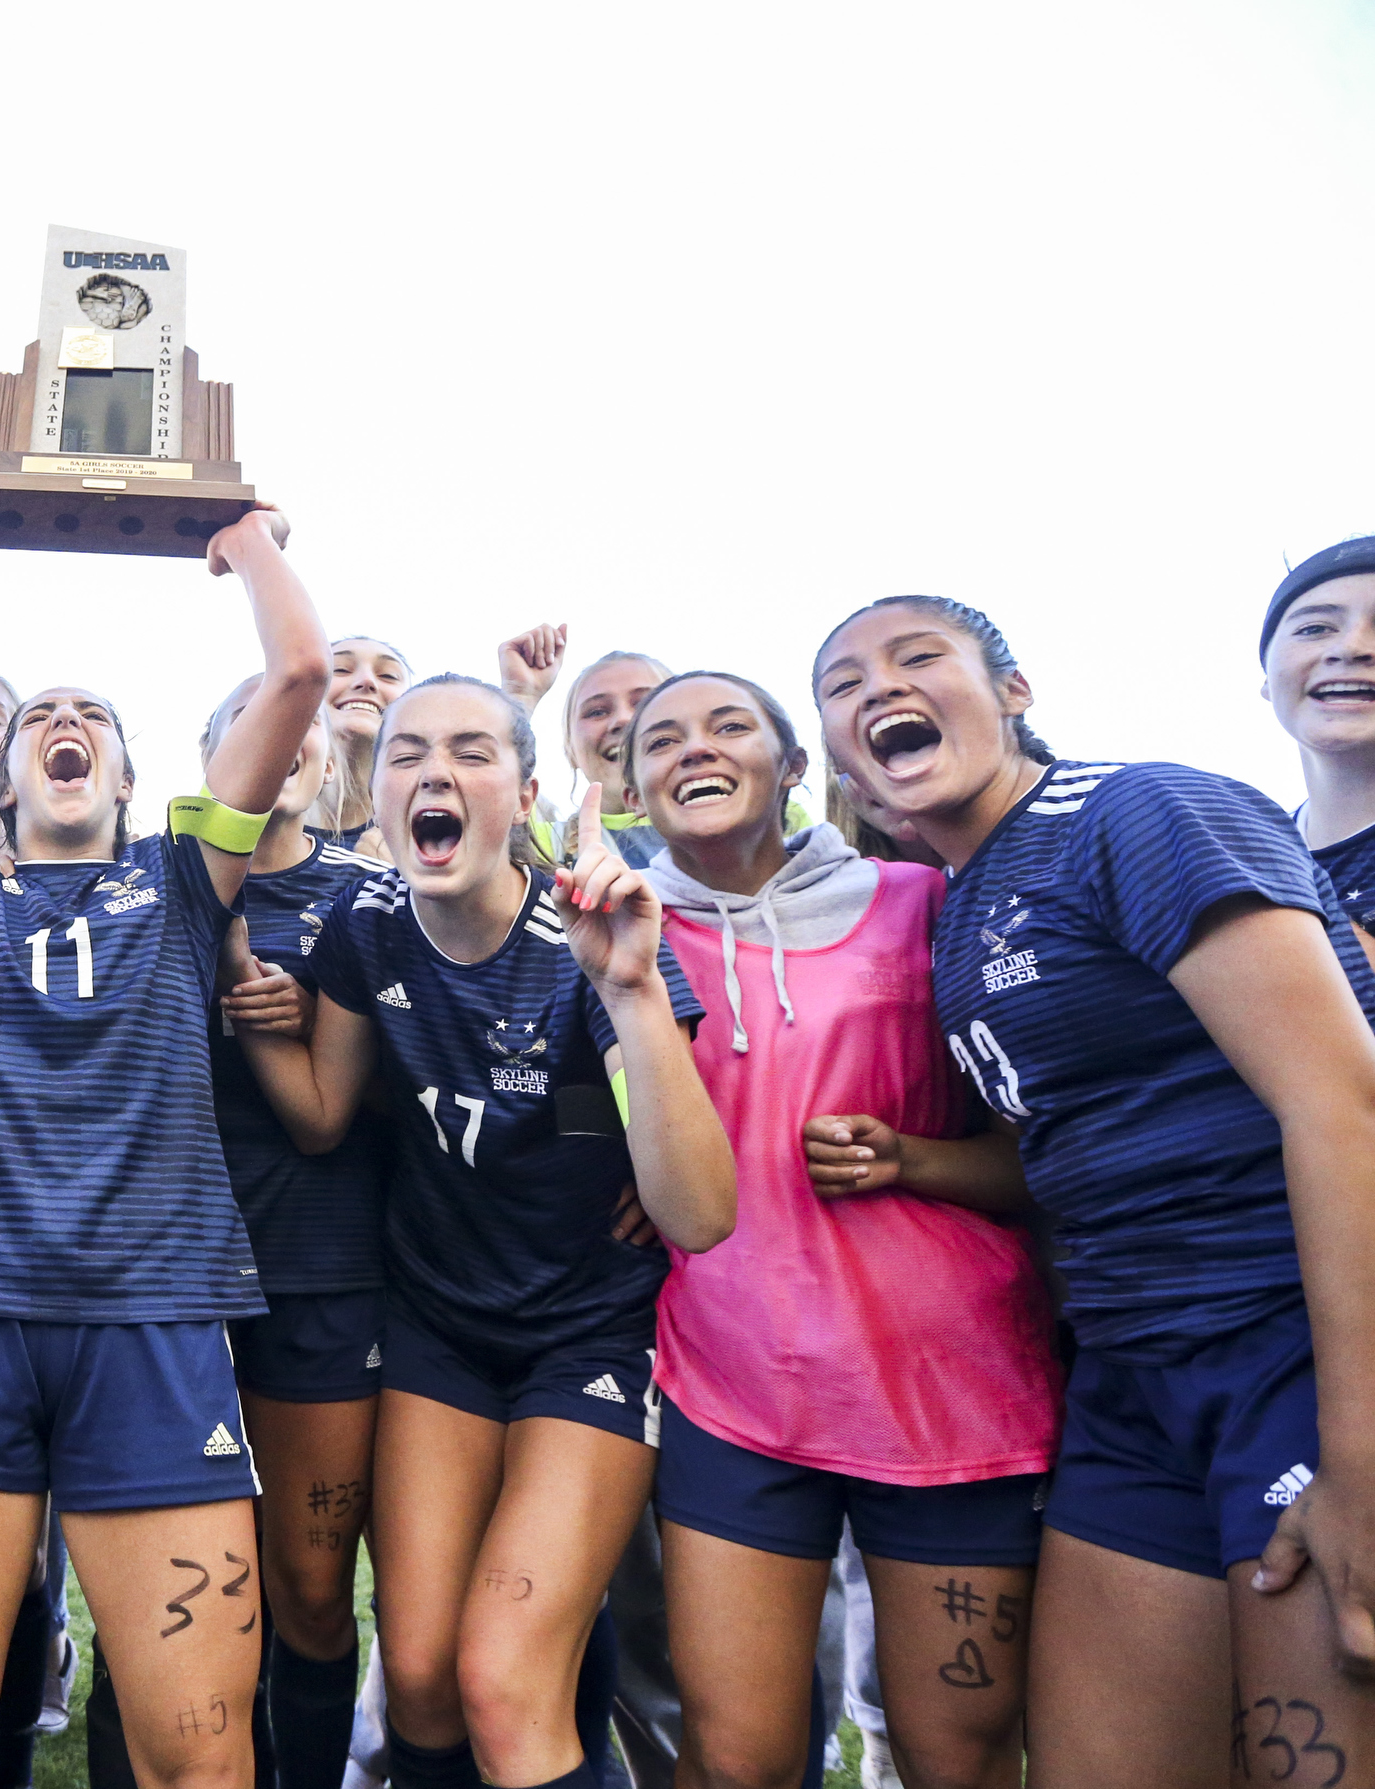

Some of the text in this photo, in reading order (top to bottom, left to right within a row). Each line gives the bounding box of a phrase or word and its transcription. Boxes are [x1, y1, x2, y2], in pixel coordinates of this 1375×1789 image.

[45, 379, 60, 436] STATE
[103, 887, 158, 911] SKYLINE
[109, 896, 161, 915] SOCCER
[25, 916, 94, 998] 11
[981, 949, 1038, 980] SKYLINE
[985, 966, 1041, 994] SOCCER
[376, 992, 412, 1010] adidas
[490, 1067, 549, 1083] SKYLINE
[493, 1079, 548, 1095] SOCCER
[416, 1086, 485, 1168] 17
[582, 1387, 626, 1404] adidas
[203, 1444, 241, 1456] adidas
[934, 1577, 1024, 1643] #5
[176, 1692, 228, 1739] #5
